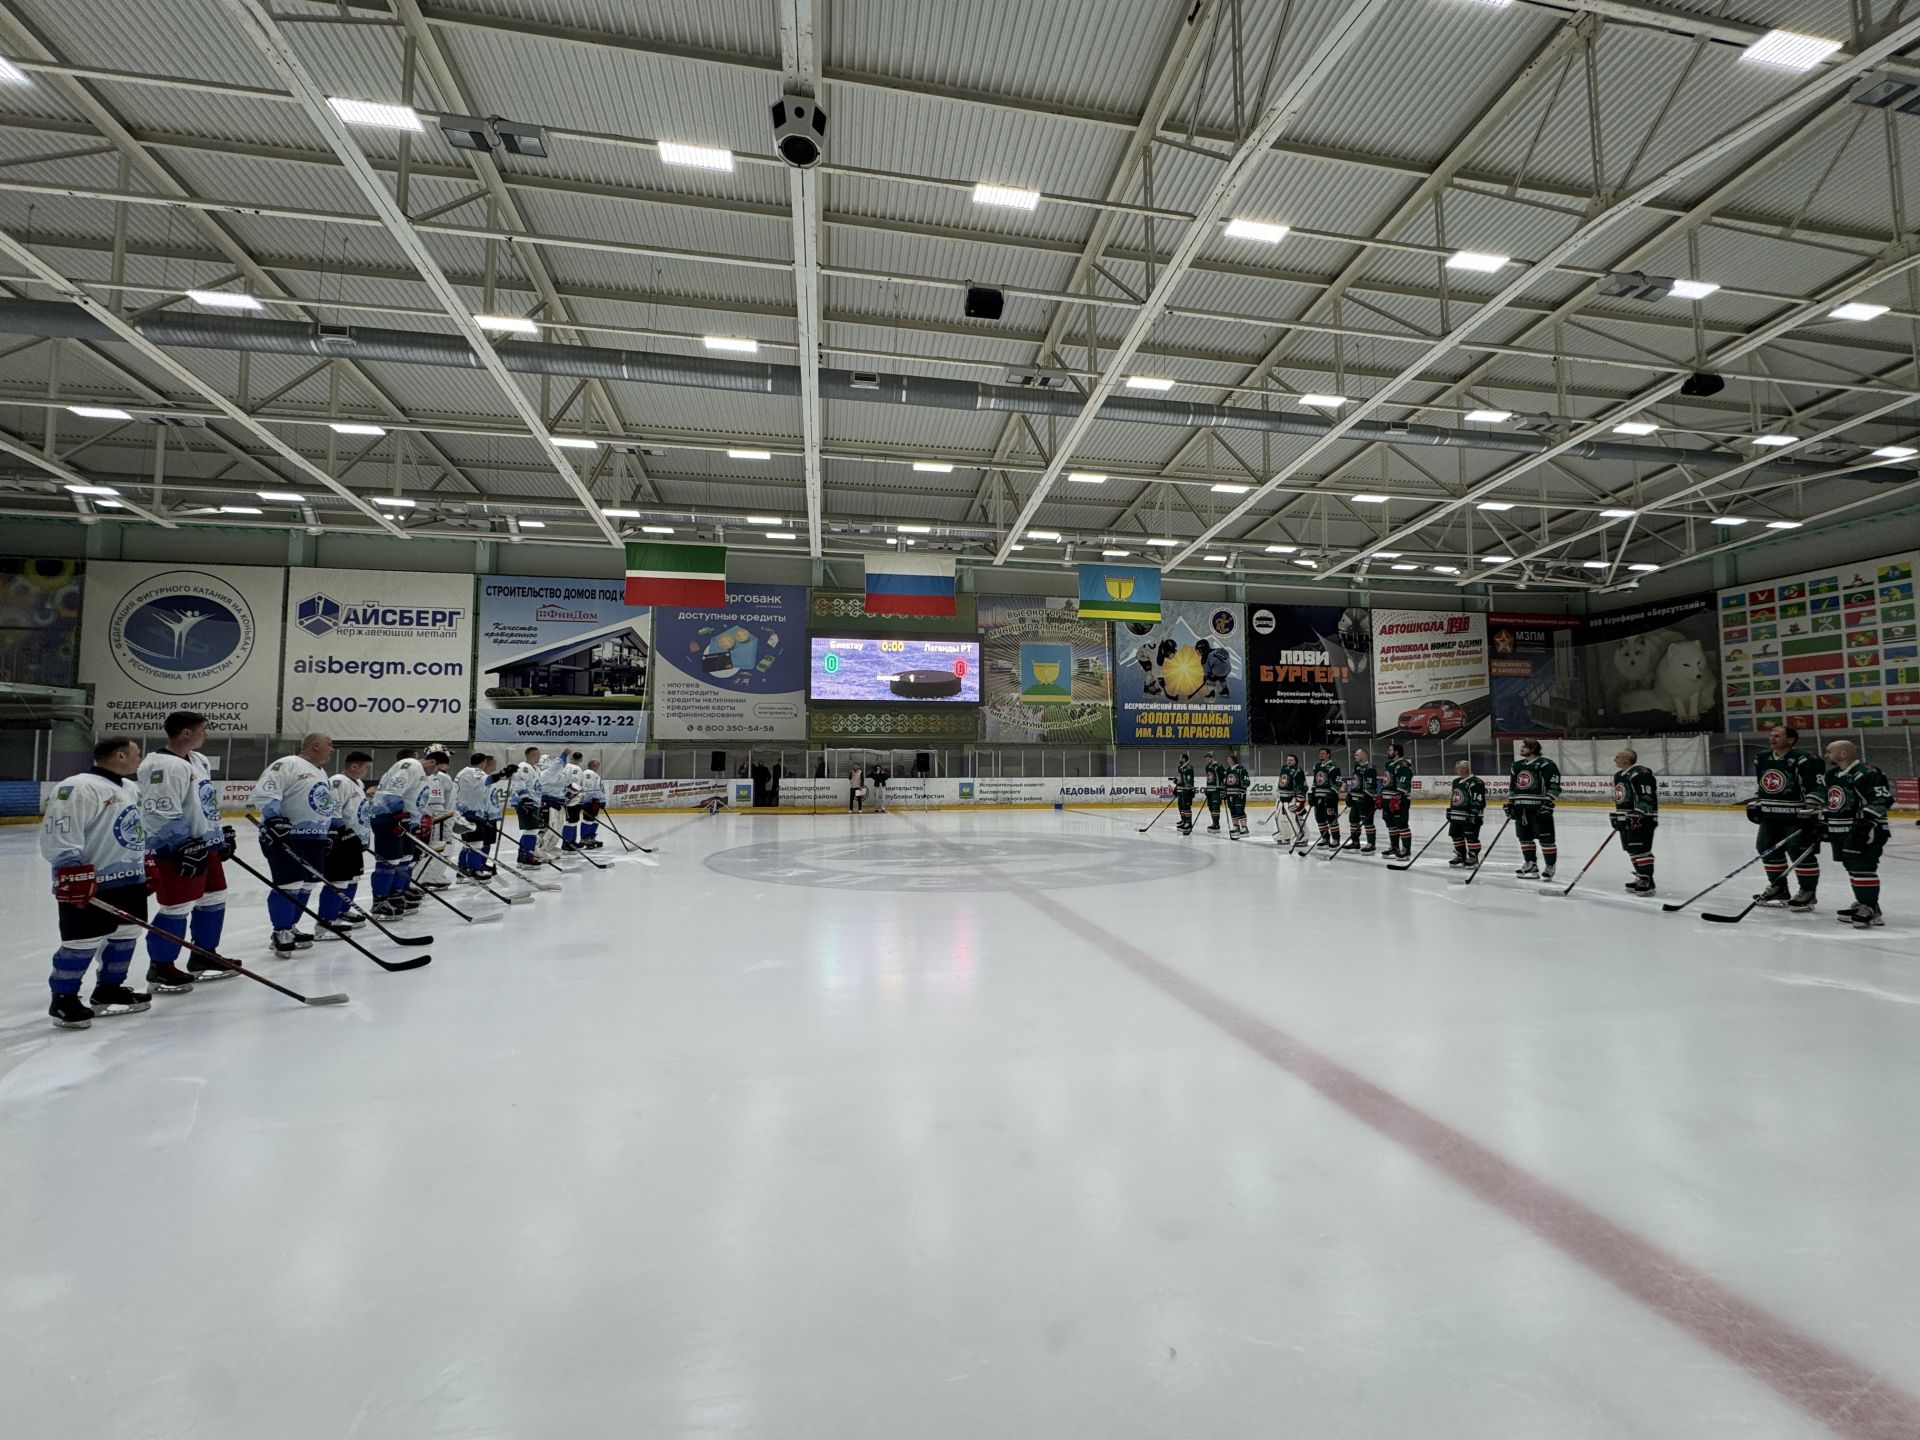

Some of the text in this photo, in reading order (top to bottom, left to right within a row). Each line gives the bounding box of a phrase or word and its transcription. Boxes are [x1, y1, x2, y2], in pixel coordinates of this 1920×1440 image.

[486, 585, 562, 599] СТРОИТЕЛЬСТВО
[563, 589, 596, 600] ДОМОВ
[599, 589, 618, 602] ПОД
[724, 593, 782, 604] ергобанк
[115, 585, 252, 652] ФЕДЕРАЦИЯ ФИГУРНОГО КАТАНИЯ НА КОНЬКАХ
[343, 603, 461, 628] АЙСБЕРГ
[678, 612, 786, 622] доступные кредиты
[1008, 609, 1078, 620] ВЫСОКОГОРСКИ
[492, 622, 538, 631] Качество
[1380, 621, 1445, 635] АВТОШКОЛА
[989, 623, 1103, 643] МУНИЦИПАЛЬНЫЙ РАЙОН
[1516, 631, 1545, 641] МЗПМ
[829, 641, 864, 650] Биектау
[882, 642, 905, 651] 0:00
[923, 643, 959, 653] Легенды
[1380, 643, 1429, 654] АВТОШКОЛА
[1430, 641, 1457, 650] НОМЕР
[1280, 650, 1330, 665] ЛОВИ
[128, 659, 233, 680] РЕСПУБЛИКА ТАТАРСТАН
[294, 655, 463, 679] aisbergm.com
[1260, 665, 1349, 683] БУРГЕР!
[106, 701, 249, 711] ФЕДЕРАЦИЯ ФИГУРНОГО
[292, 697, 461, 713] 8-800-700-9710
[113, 712, 241, 720] КАТАНИЯ НЬКАХ
[516, 714, 634, 728] 8(843)249-12-22
[105, 722, 248, 731] РЕСПУБЛИ АРСТАН
[518, 729, 608, 737] www.findomkzn.ru
[1136, 727, 1153, 738] ИМ.
[1177, 727, 1231, 738] ТАРАСОВА
[629, 781, 678, 792] АВТОШКОЛА
[1060, 785, 1105, 796] ЛЕДОВЫЙ
[1109, 787, 1146, 797] ДВОРЕЦ
[1150, 785, 1175, 795] БИЕК
[96, 868, 145, 884] ВЫСОК
